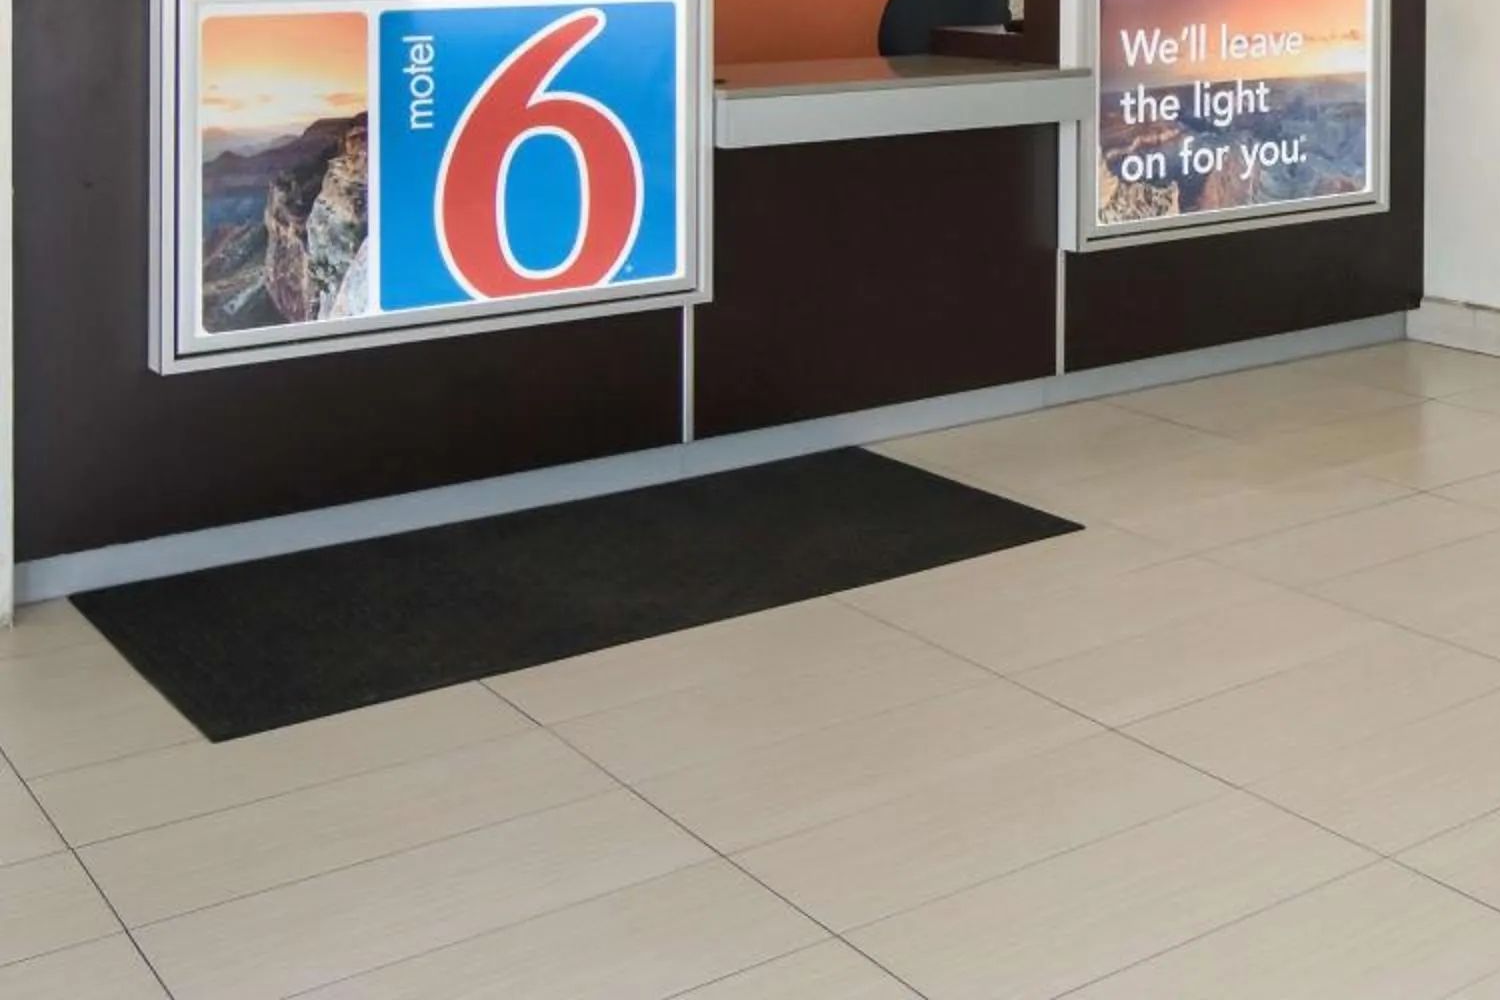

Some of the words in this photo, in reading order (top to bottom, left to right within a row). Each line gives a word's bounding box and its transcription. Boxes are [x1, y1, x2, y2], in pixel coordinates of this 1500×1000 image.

[1121, 24, 1206, 67] We'll
[1221, 24, 1304, 61] leave
[1120, 84, 1179, 125] the
[1194, 79, 1271, 127] light
[403, 34, 435, 130] motel
[433, 7, 645, 300] 6
[1121, 152, 1167, 181] on
[1179, 136, 1229, 175] for
